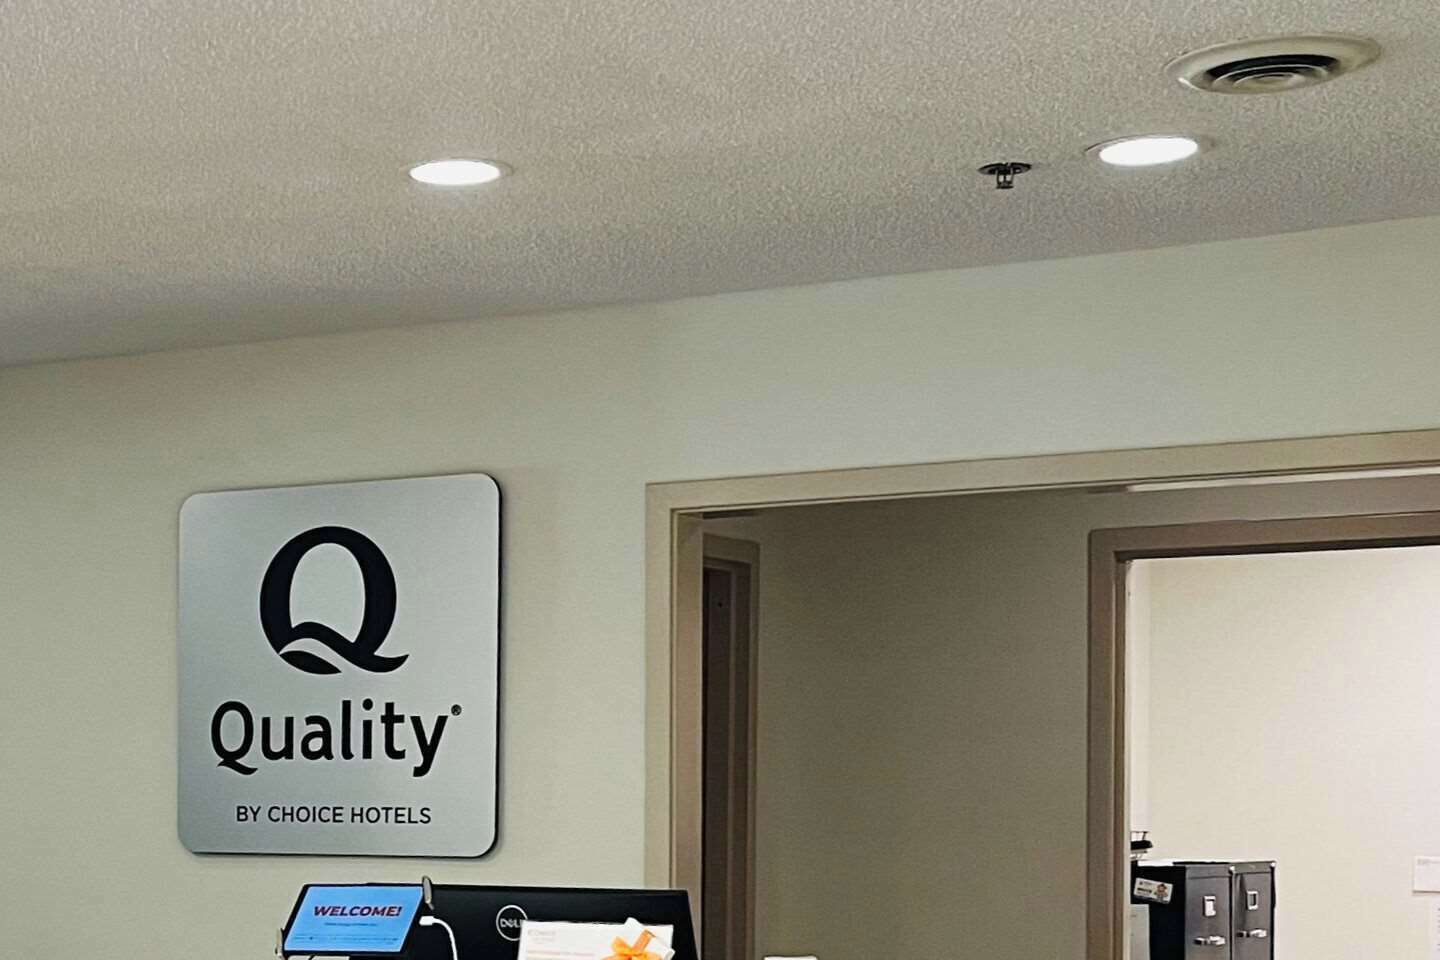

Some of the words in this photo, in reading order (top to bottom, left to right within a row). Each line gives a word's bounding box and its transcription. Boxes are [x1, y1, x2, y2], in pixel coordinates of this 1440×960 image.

[260, 525, 410, 675] Q
[235, 805, 260, 823] BY
[267, 805, 344, 824] CHOICE
[350, 806, 432, 824] HOTELS
[313, 905, 403, 917] WELCOME!
